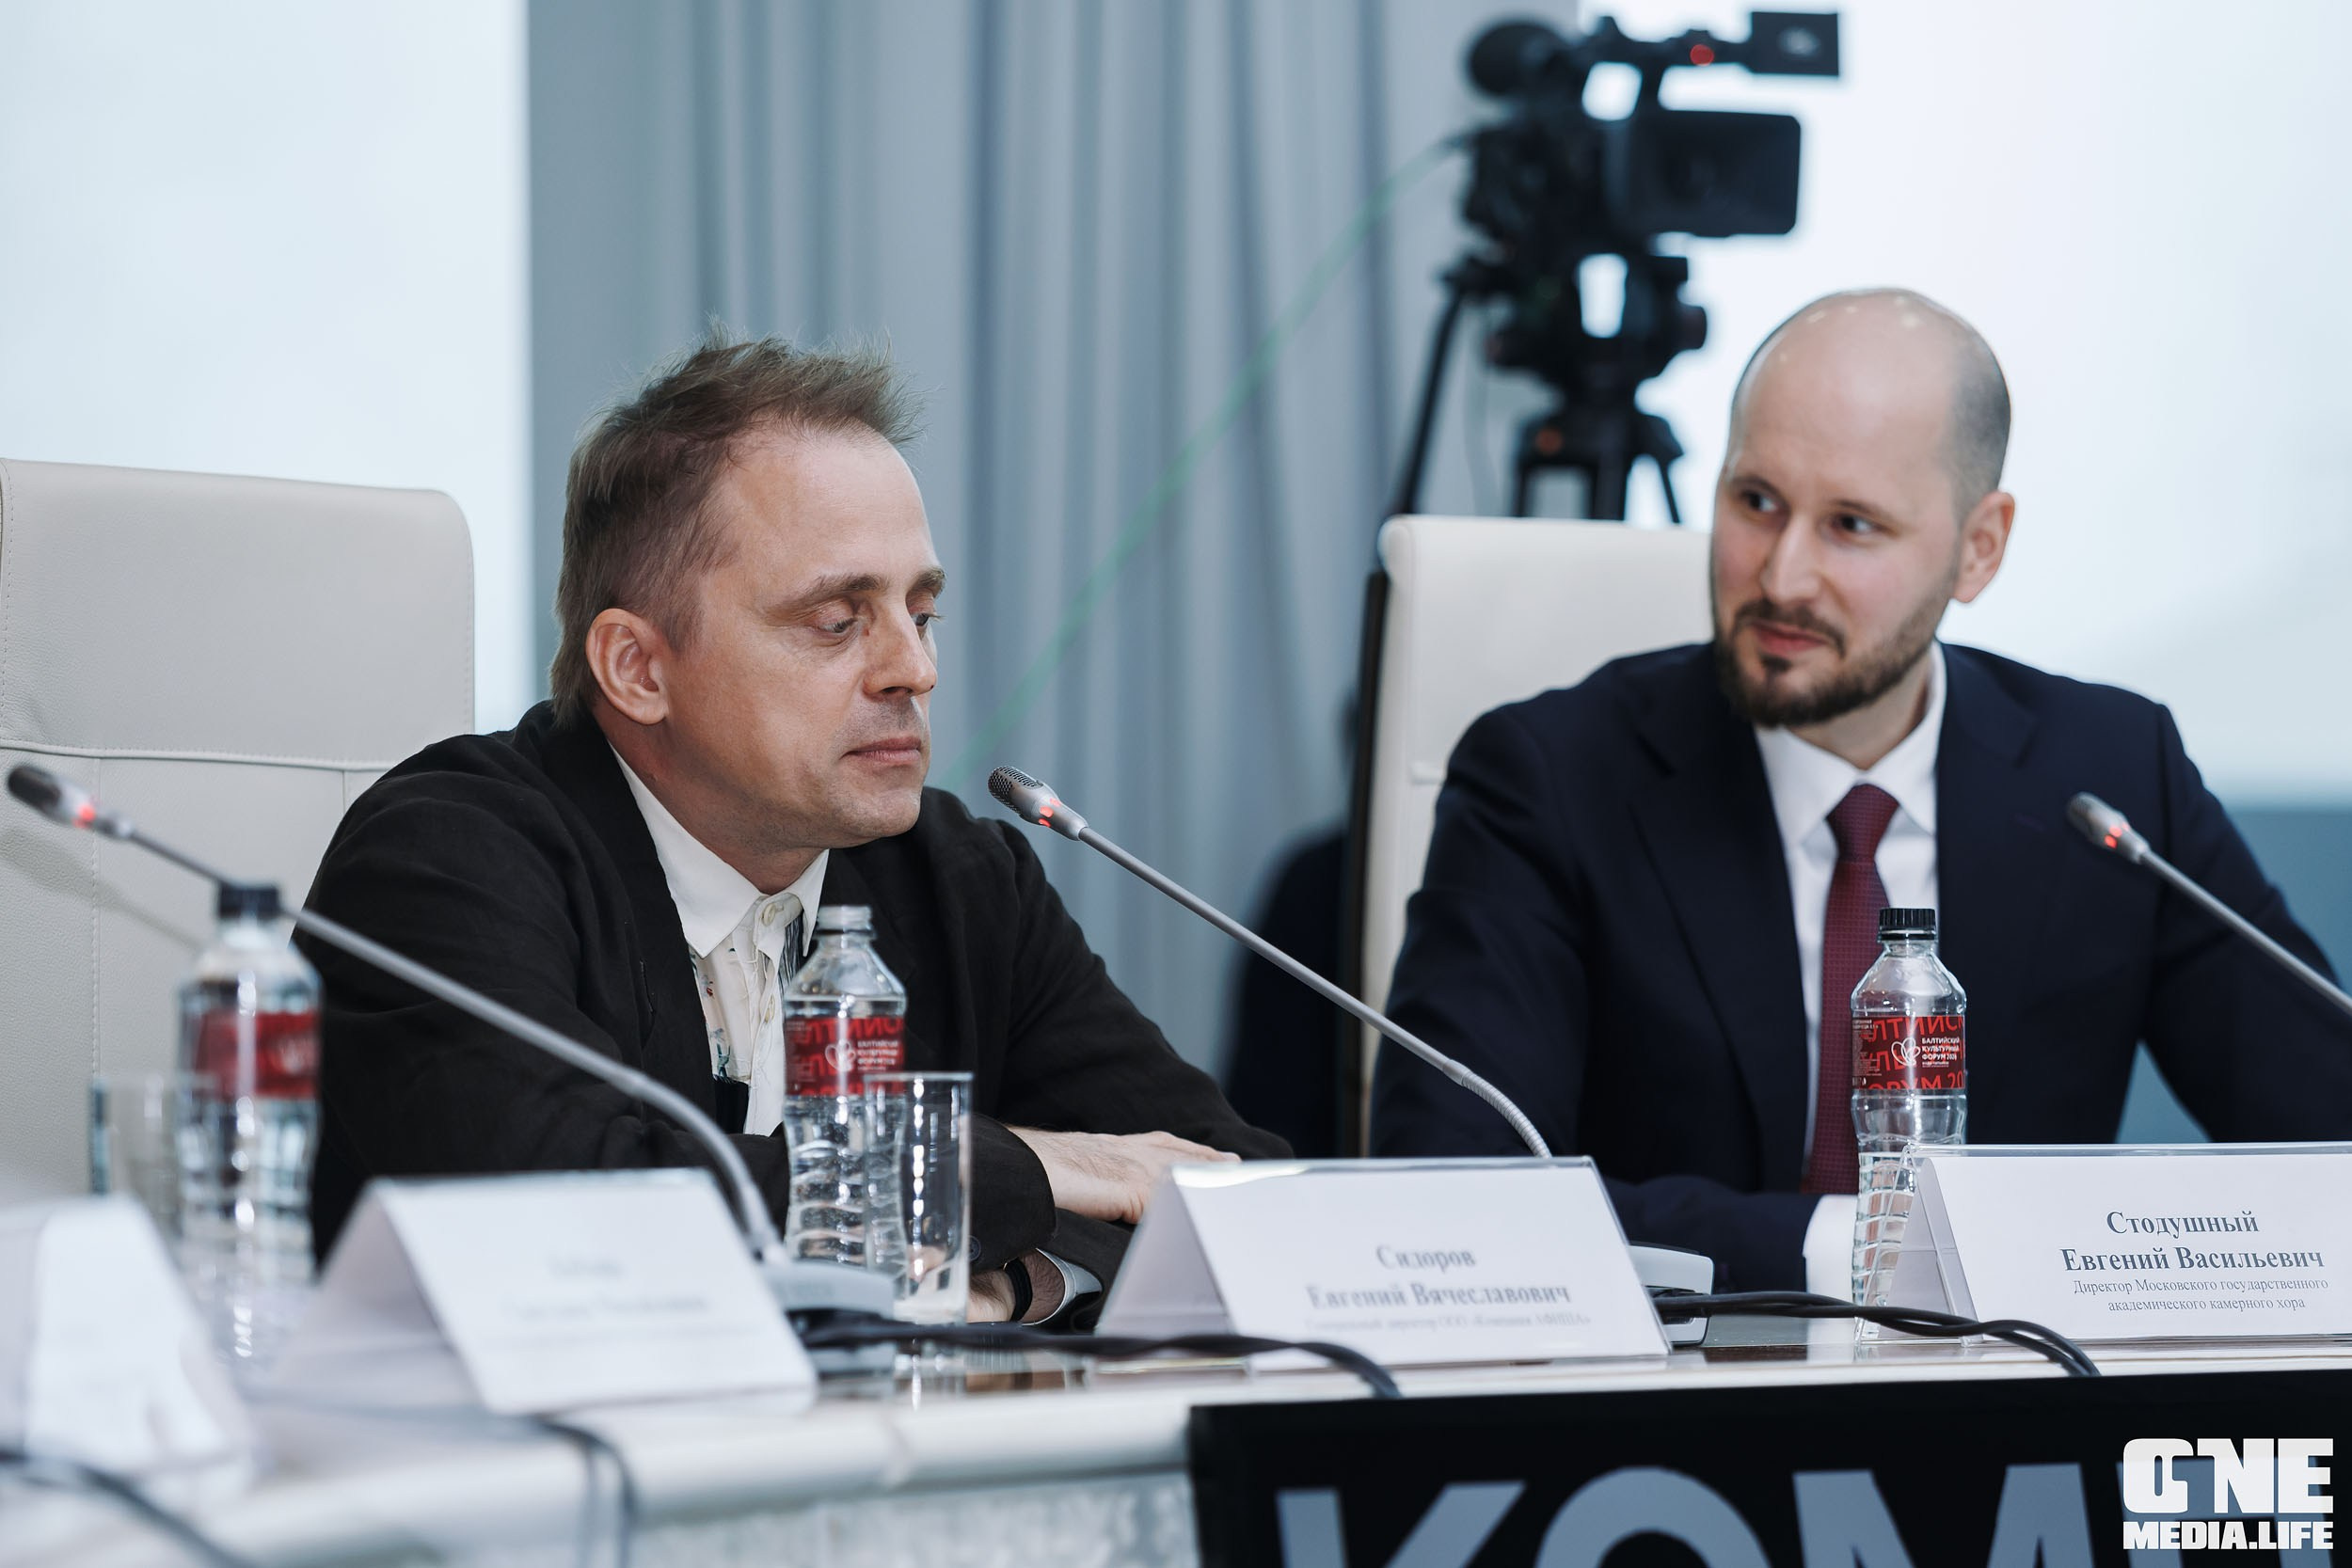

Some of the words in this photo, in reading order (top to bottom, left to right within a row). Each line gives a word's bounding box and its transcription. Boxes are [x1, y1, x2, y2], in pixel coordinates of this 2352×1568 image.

[2106, 1210, 2260, 1239] Стодушный
[1375, 1244, 1476, 1273] Сидоров
[2060, 1247, 2169, 1271] Евгений
[2173, 1246, 2325, 1270] Васильевич
[1306, 1282, 1407, 1309] Евгений
[1410, 1281, 1572, 1307] Вячеславович
[2073, 1280, 2133, 1295] Директор
[2135, 1279, 2217, 1291] Московского
[2220, 1279, 2328, 1292] государственного
[2107, 1300, 2206, 1311] академического
[2210, 1299, 2274, 1312] камерного
[2276, 1299, 2306, 1311] хора
